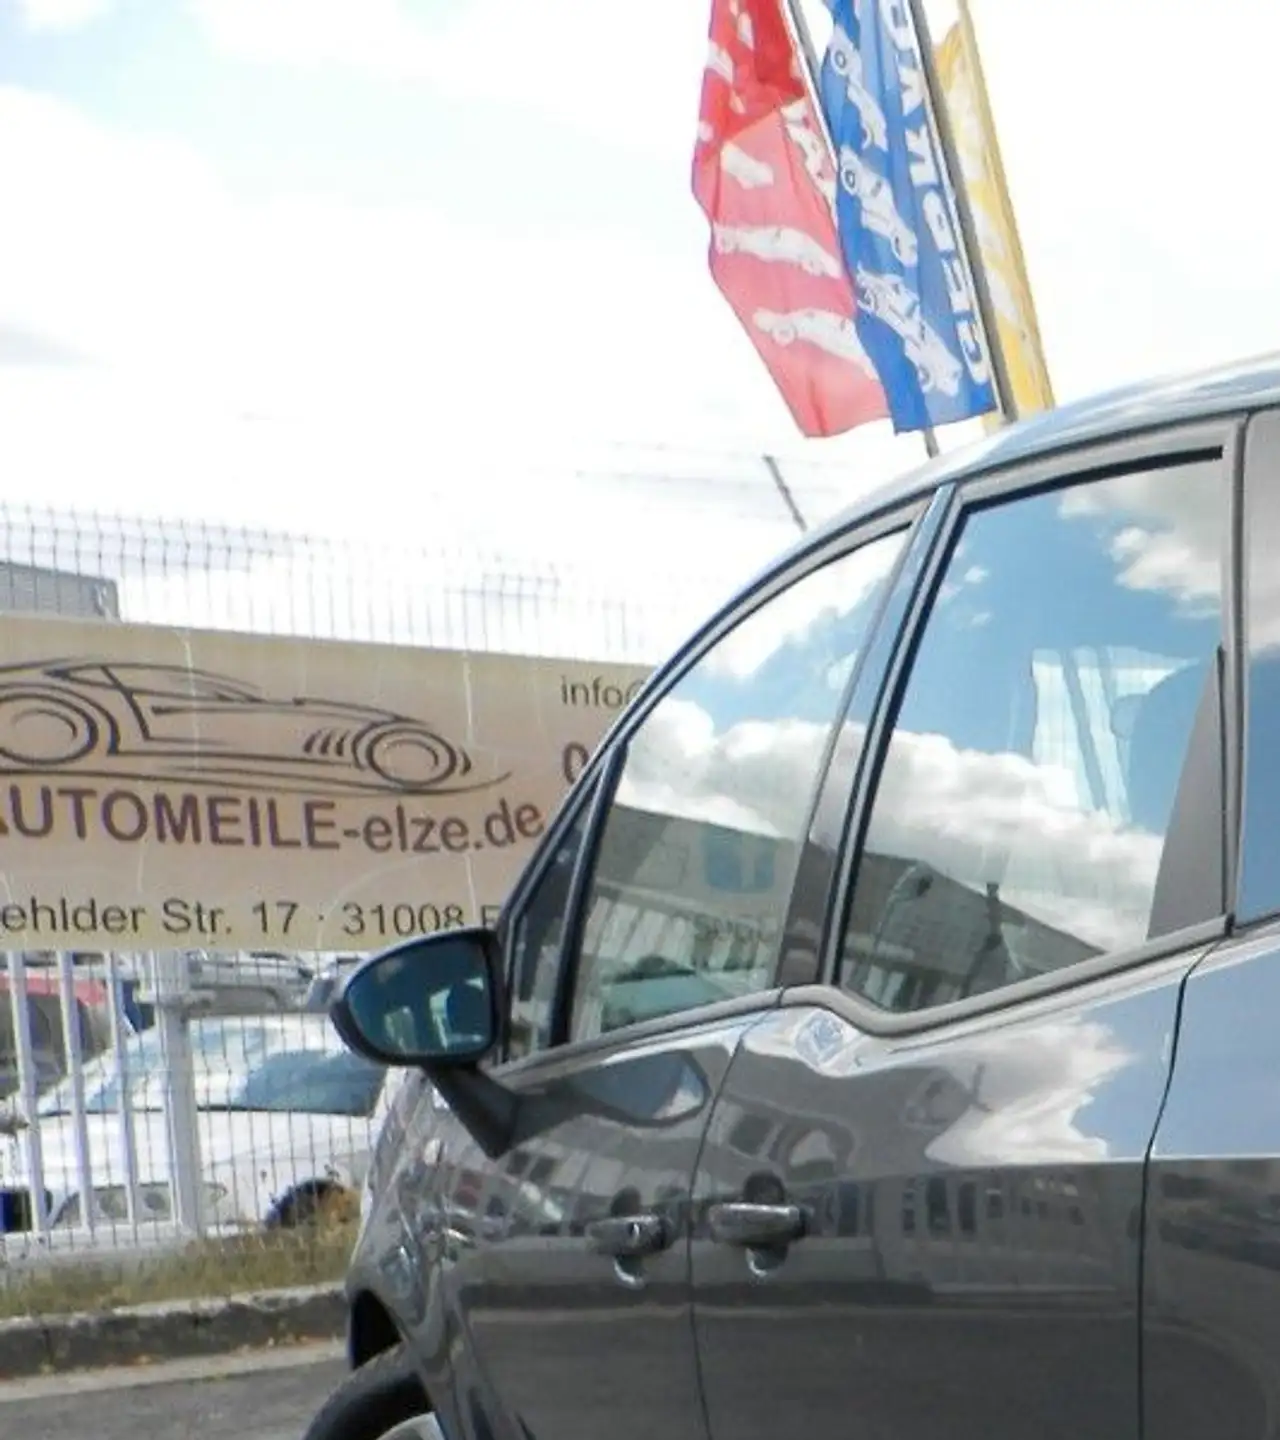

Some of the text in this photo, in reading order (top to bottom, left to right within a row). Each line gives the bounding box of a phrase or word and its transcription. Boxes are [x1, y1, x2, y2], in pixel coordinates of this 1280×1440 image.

[0, 784, 545, 853] UTOMEILE-elze.de
[162, 897, 232, 934] Str.
[252, 901, 298, 933] 17
[342, 903, 464, 936] 31008
